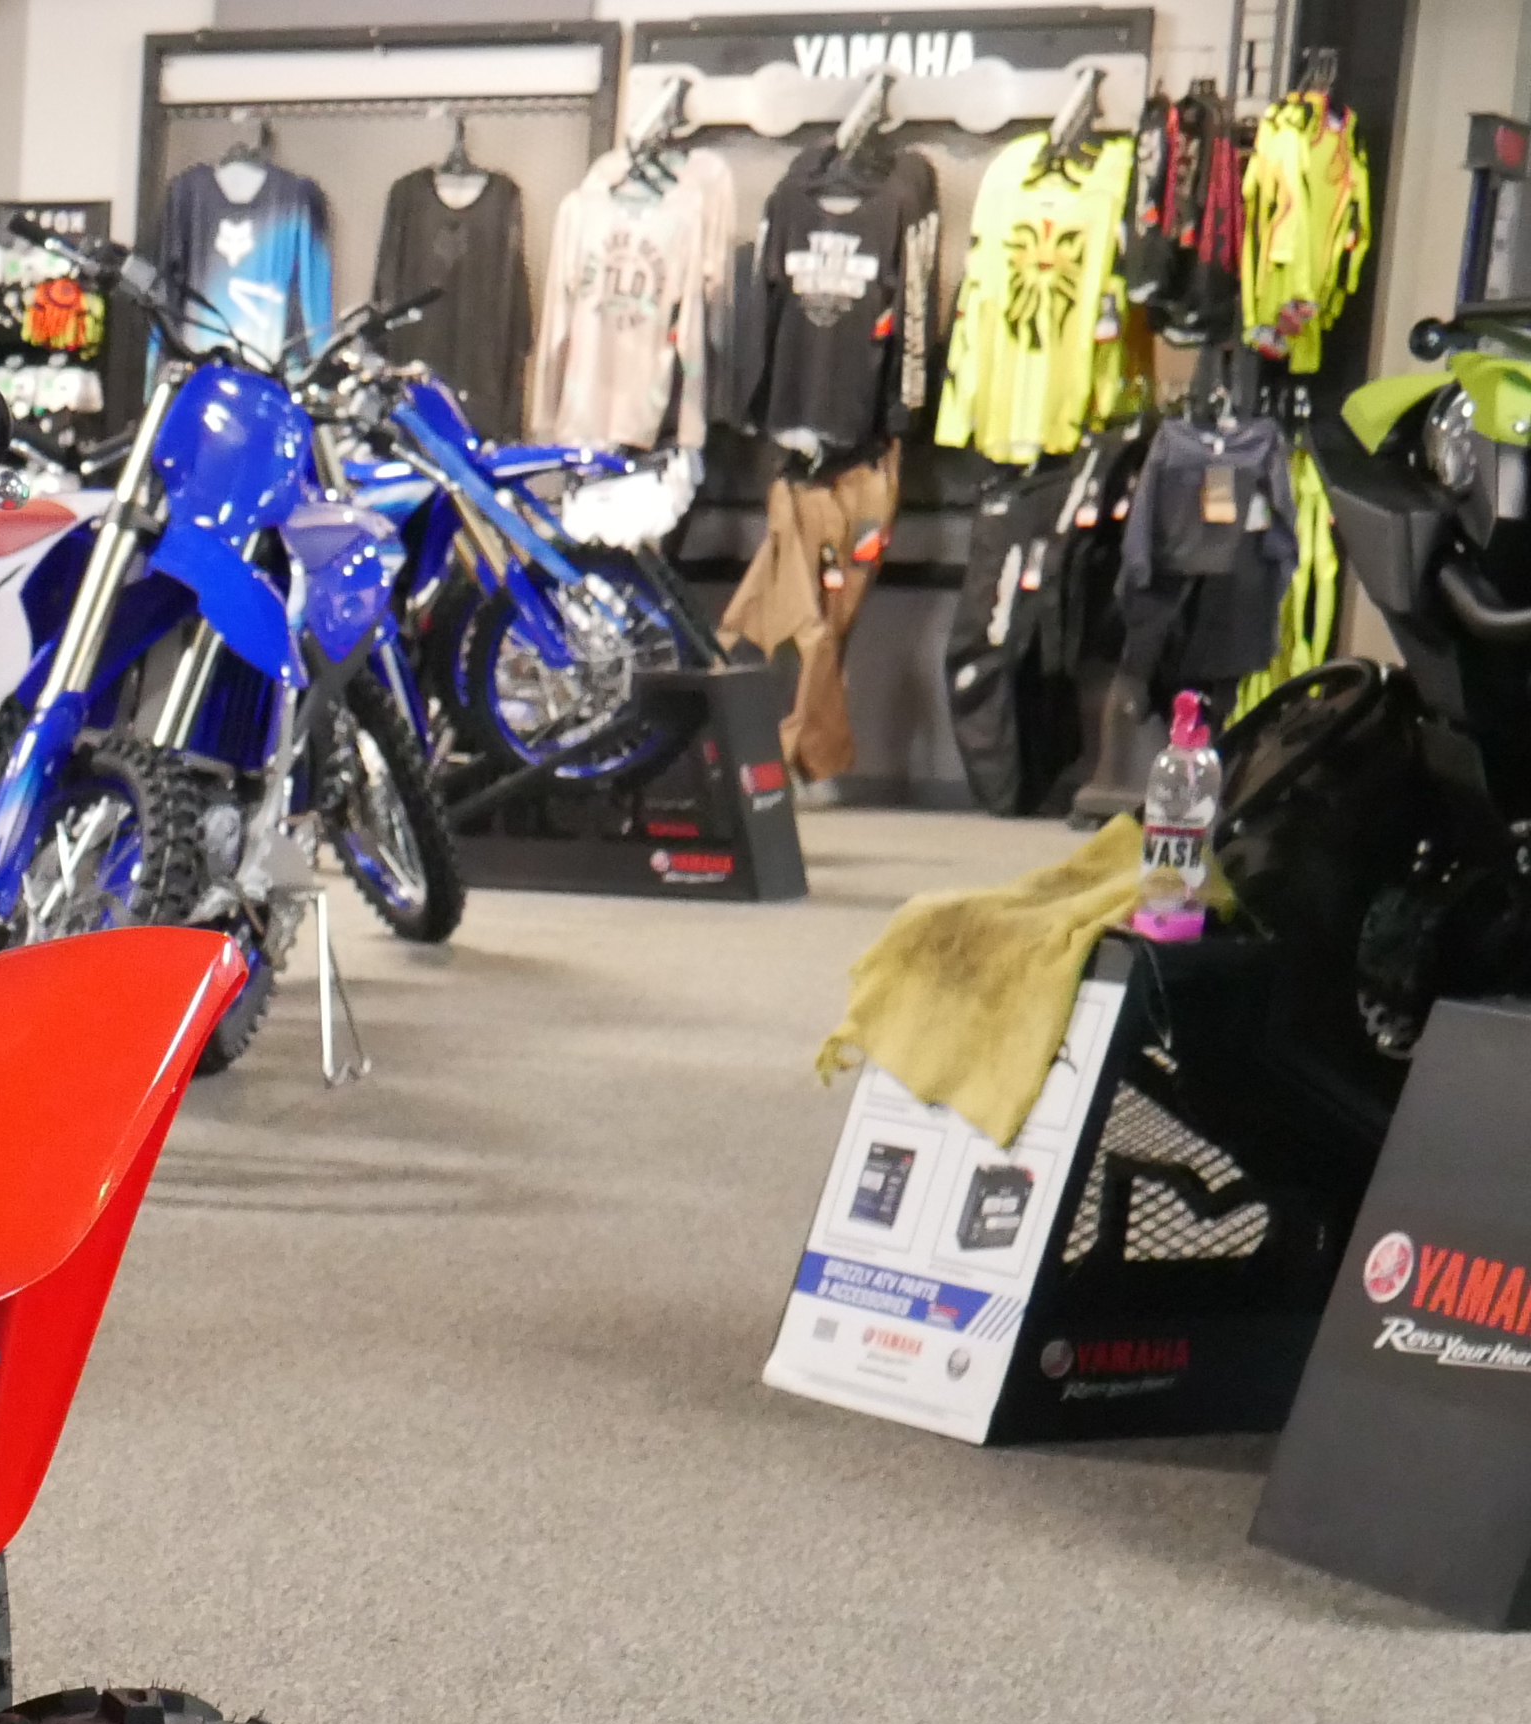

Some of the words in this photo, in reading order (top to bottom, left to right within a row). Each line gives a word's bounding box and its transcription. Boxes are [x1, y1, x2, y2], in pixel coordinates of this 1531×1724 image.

[794, 31, 974, 79] YAMAHA
[1373, 1315, 1446, 1354] Revs
[1489, 1342, 1531, 1371] Hear
